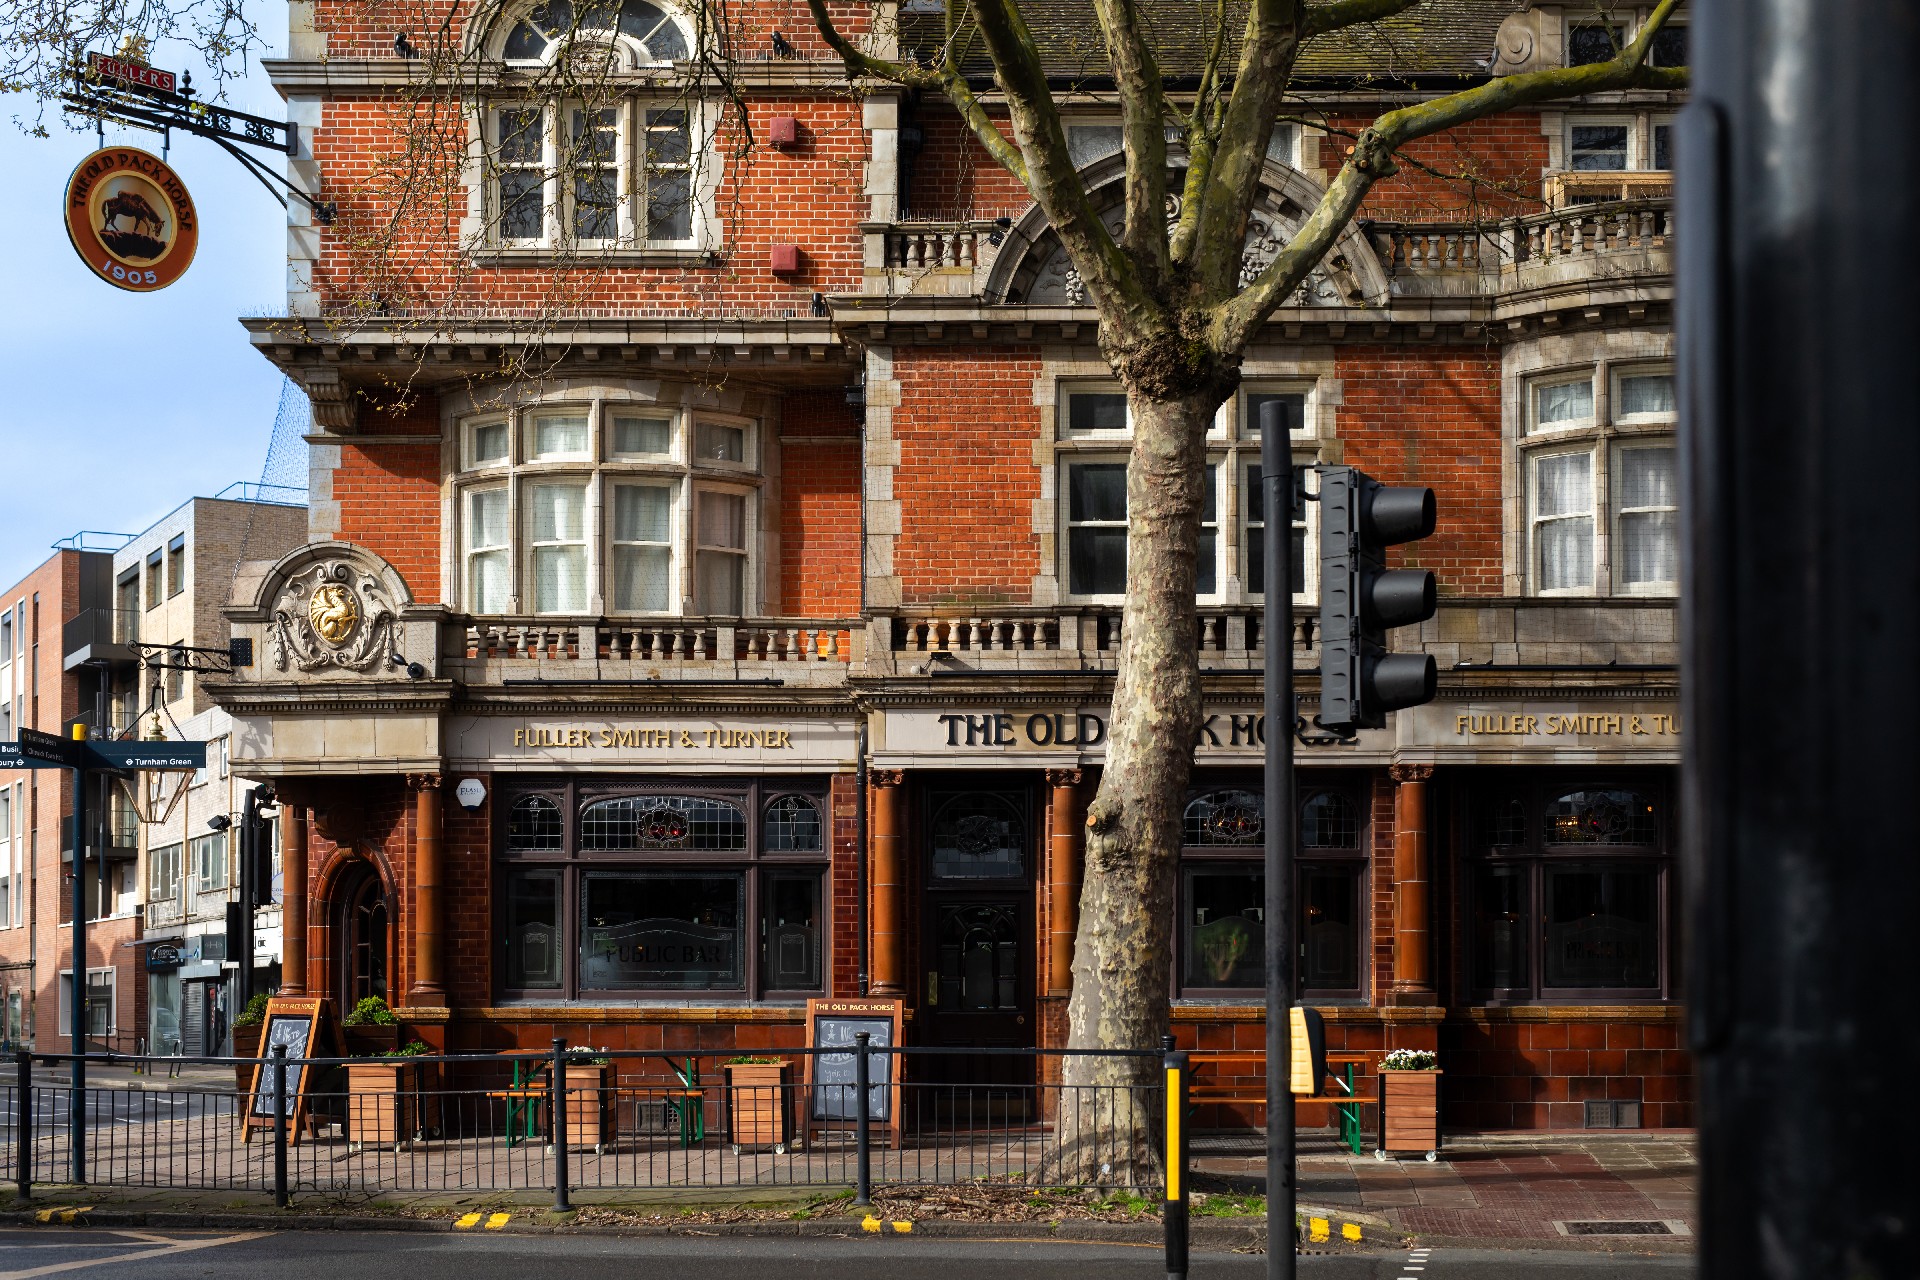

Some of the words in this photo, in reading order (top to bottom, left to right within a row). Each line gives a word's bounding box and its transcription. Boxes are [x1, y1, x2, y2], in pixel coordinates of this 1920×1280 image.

[72, 175, 91, 209] THE
[86, 155, 115, 178] OLD
[117, 153, 164, 180] PACK
[163, 177, 192, 232] HORSE
[103, 260, 157, 284] 1905
[938, 713, 1016, 746] THE
[1026, 713, 1106, 746] OLD
[1456, 715, 1538, 735] FULLER
[1545, 715, 1621, 735] SMITH
[1629, 715, 1645, 734] &
[513, 728, 592, 748] FULLER
[599, 728, 672, 748] SMITH
[679, 729, 697, 748] &
[703, 728, 793, 749] TURNER
[134, 758, 168, 766] Turnham
[169, 758, 192, 766] Green
[605, 945, 676, 963] PUBLIC
[682, 945, 720, 963] BAR
[815, 1003, 829, 1011] THE
[831, 1003, 847, 1011] OLD
